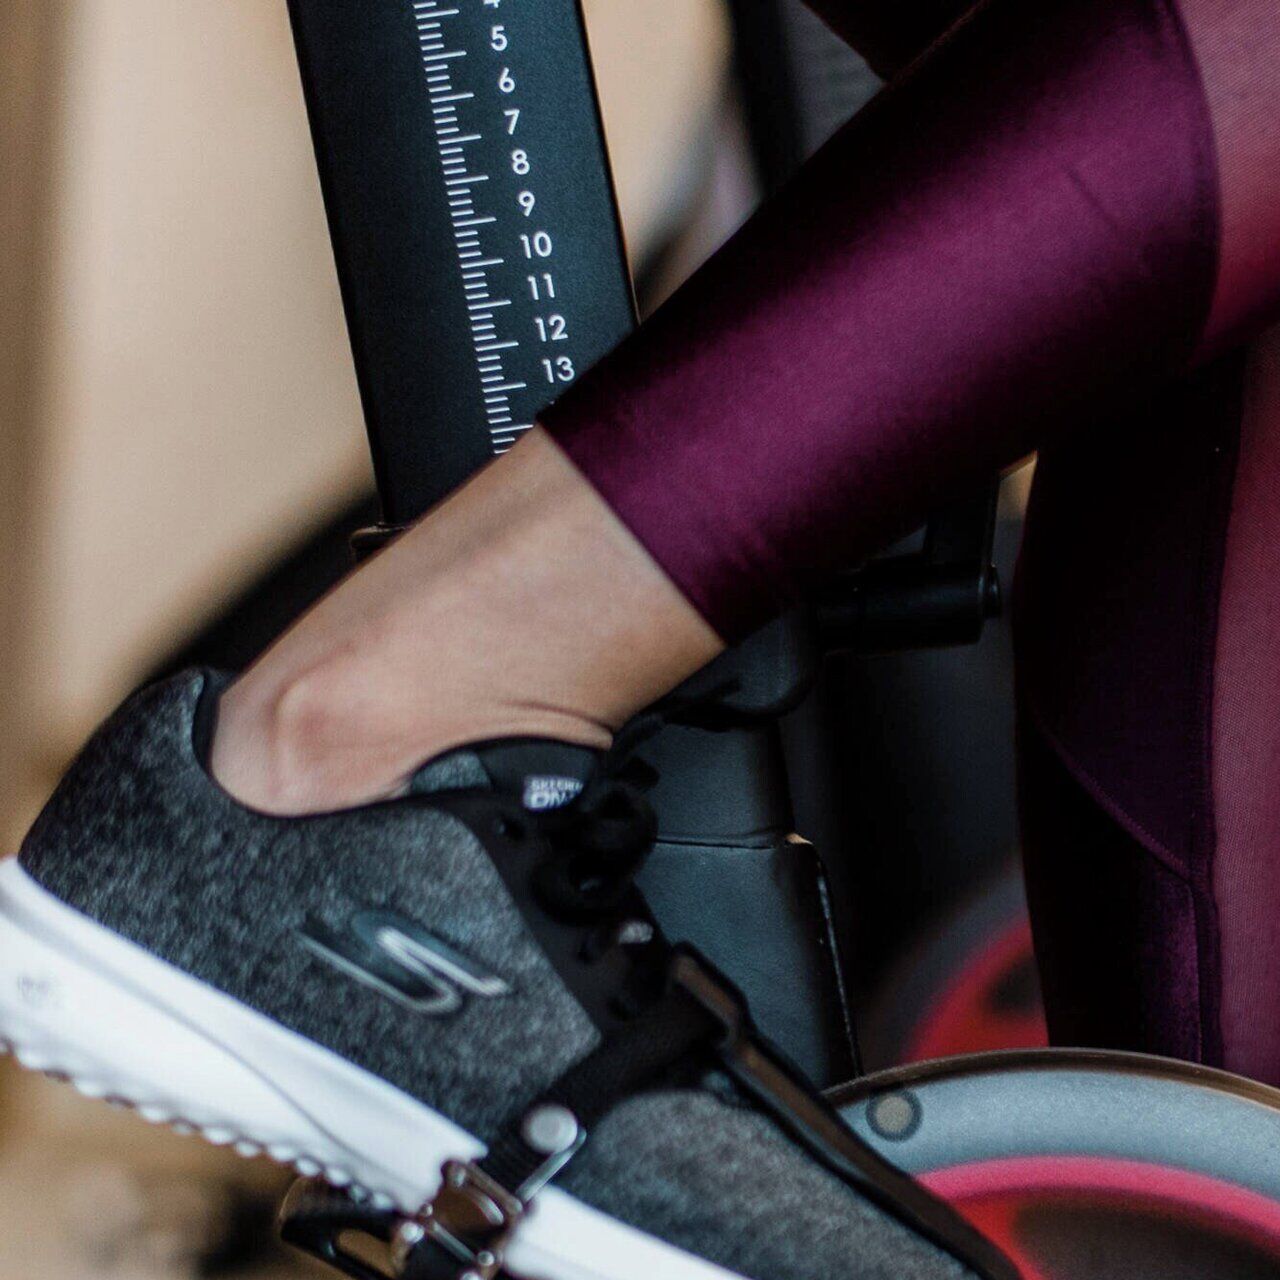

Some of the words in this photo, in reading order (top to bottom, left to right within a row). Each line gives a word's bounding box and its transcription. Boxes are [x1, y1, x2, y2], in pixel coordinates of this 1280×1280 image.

[490, 24, 508, 52] 5
[498, 67, 516, 94] 6
[503, 108, 521, 136] 7
[511, 148, 531, 176] 8
[517, 190, 536, 217] 9
[519, 230, 553, 260] 10
[527, 272, 556, 301] 11
[534, 313, 569, 342] 12
[542, 356, 576, 384] 13
